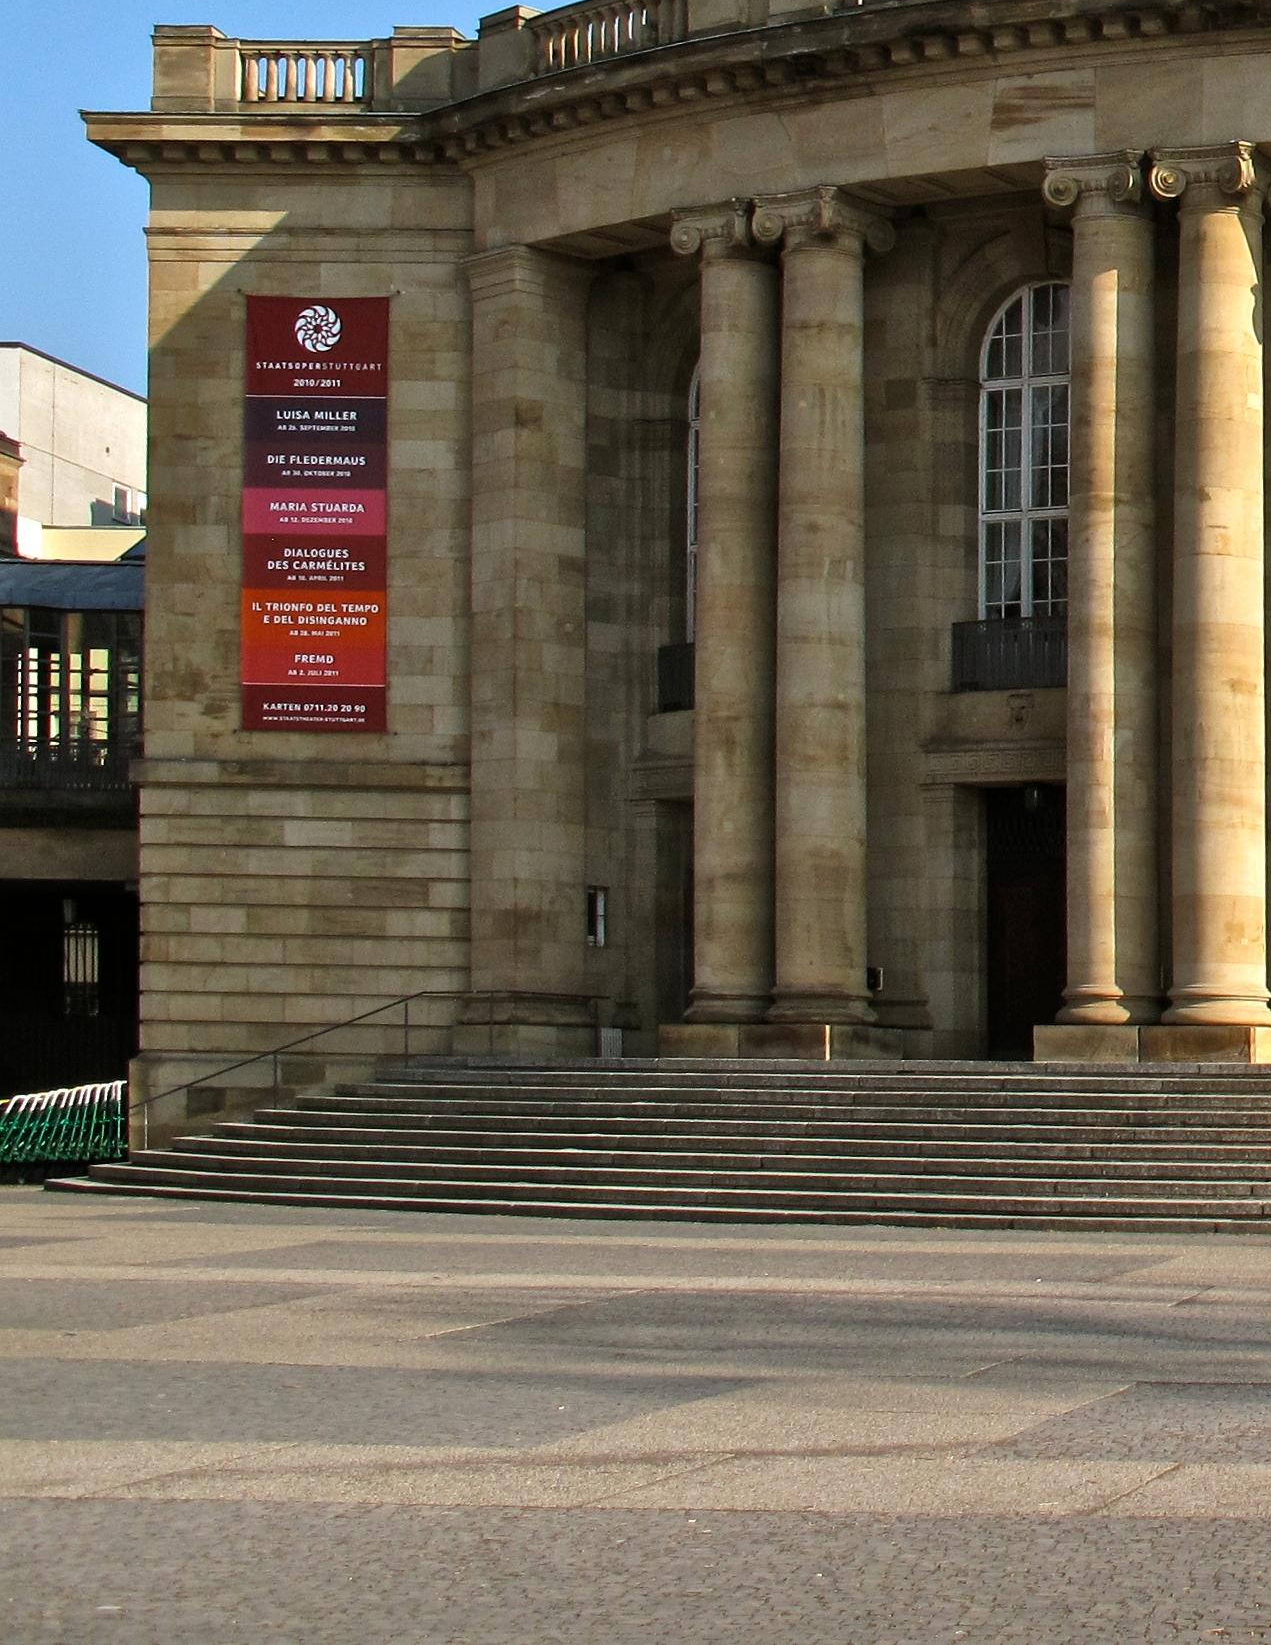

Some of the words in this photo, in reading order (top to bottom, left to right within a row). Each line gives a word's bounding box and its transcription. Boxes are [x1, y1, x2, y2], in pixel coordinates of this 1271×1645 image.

[294, 379, 341, 387] 2010/2011
[276, 411, 310, 420] LUISA
[314, 411, 357, 420] MILLER
[267, 455, 286, 464] DIE
[290, 455, 366, 466] FLEDERMAUS
[270, 502, 307, 511] MARIA
[311, 503, 365, 512] STUARDA
[284, 548, 349, 558] DIALOGUES
[267, 560, 289, 570] DES
[293, 559, 366, 571] CARMÉLITES
[252, 602, 262, 611] IL
[266, 603, 313, 612] TRIONFO
[316, 604, 337, 612] DEL
[341, 604, 379, 613] TEMPO
[263, 615, 270, 624] E
[274, 616, 294, 624] DEL
[298, 616, 367, 625] DISINGANNO
[295, 654, 334, 664] FREMD
[263, 703, 301, 711] KARTEN
[303, 704, 339, 712] 0711.20
[341, 704, 352, 712] 20
